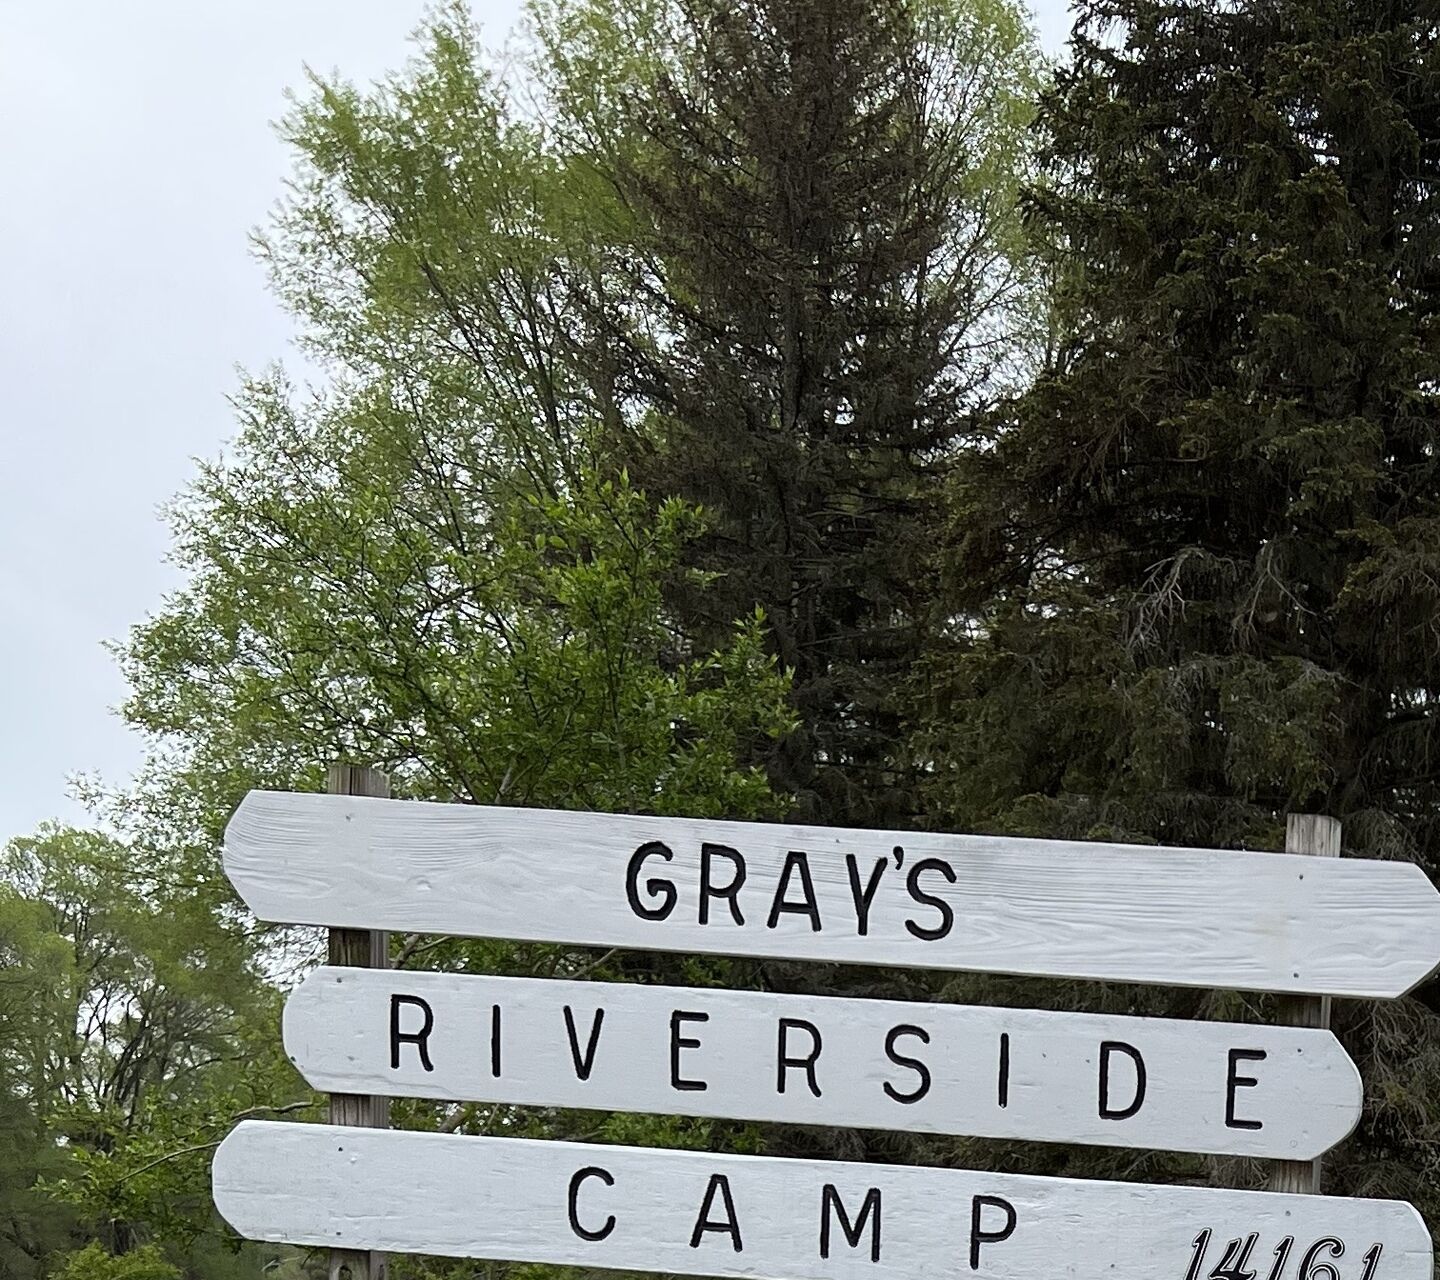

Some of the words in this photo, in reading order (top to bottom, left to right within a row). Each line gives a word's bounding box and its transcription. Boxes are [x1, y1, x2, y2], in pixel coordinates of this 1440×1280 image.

[626, 841, 957, 941] GRAY'S
[389, 994, 1268, 1130] RIVERSIDE
[567, 1166, 1017, 1270] CAMP
